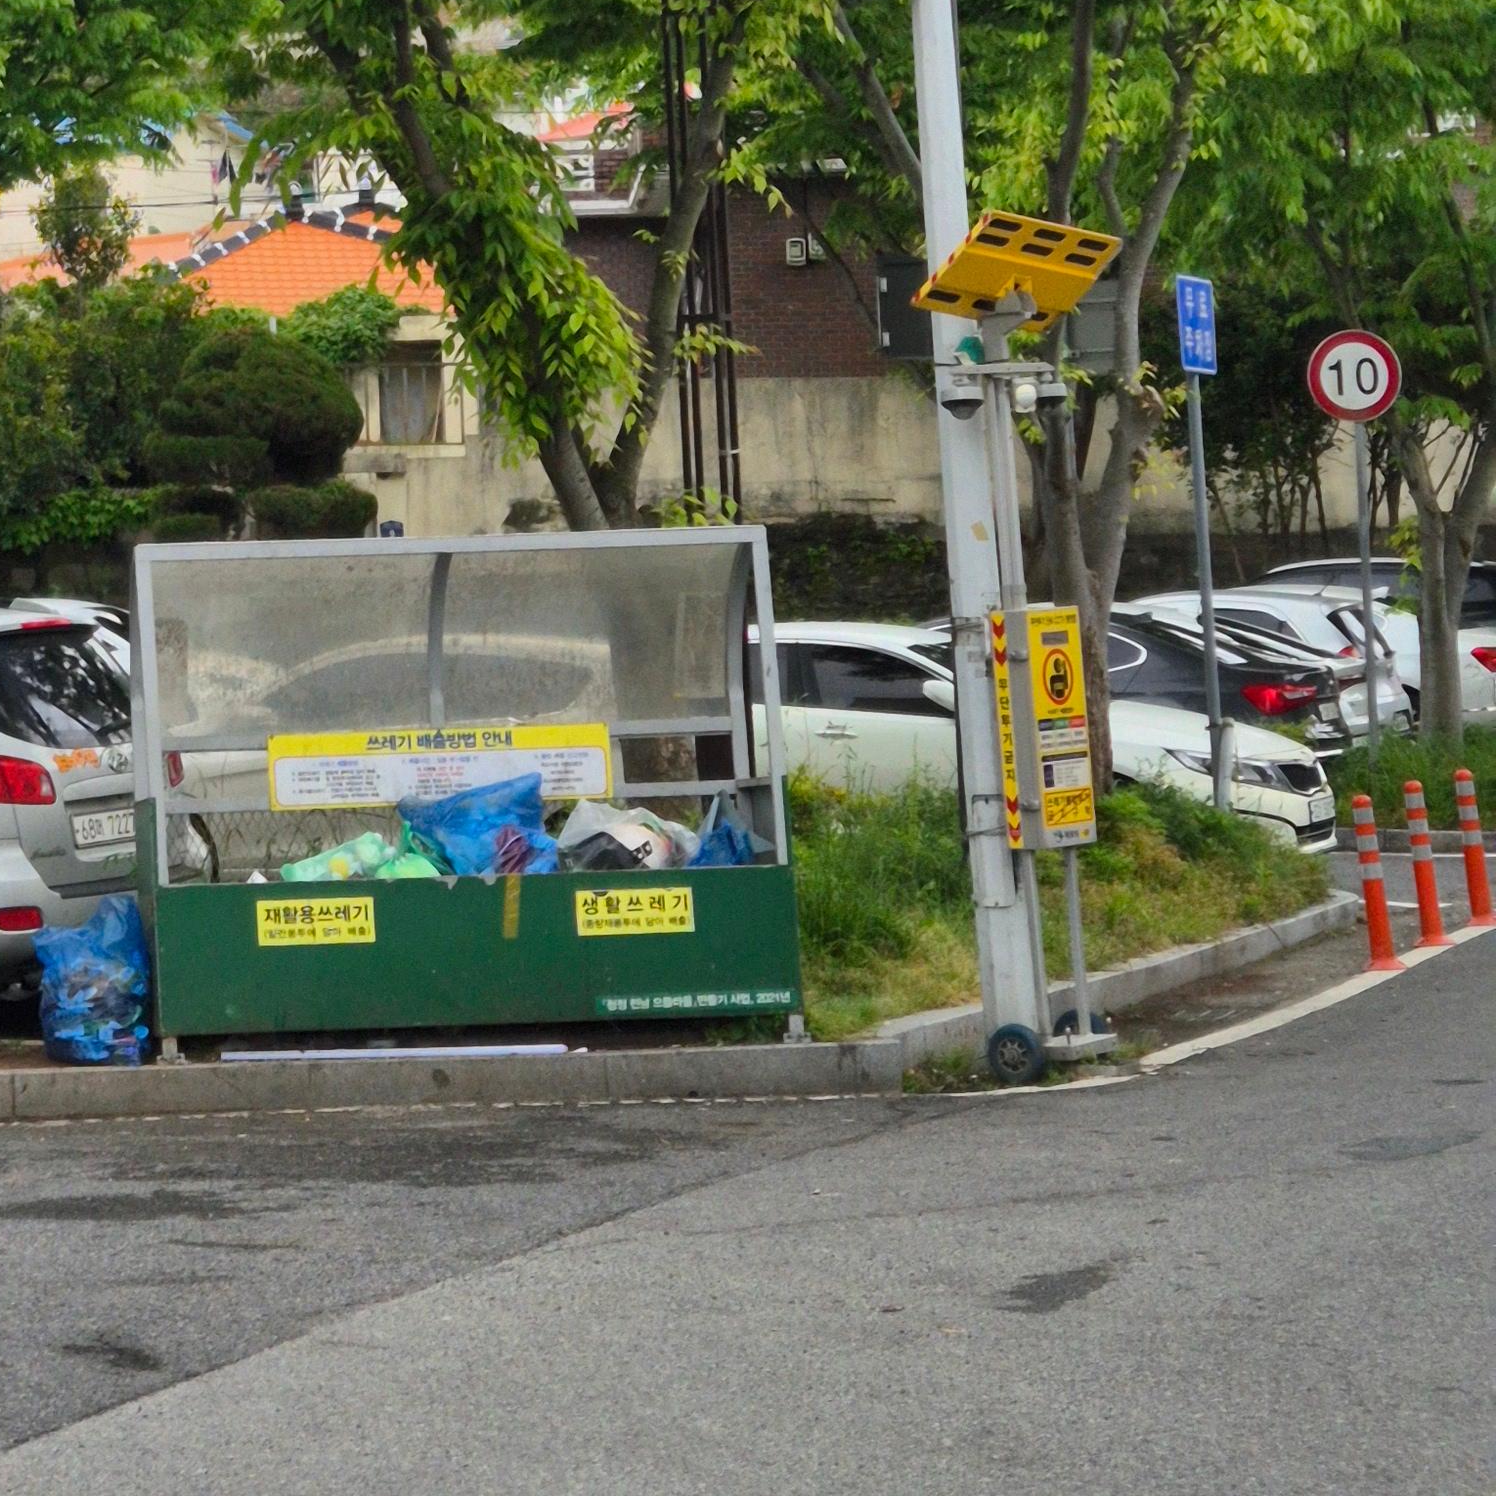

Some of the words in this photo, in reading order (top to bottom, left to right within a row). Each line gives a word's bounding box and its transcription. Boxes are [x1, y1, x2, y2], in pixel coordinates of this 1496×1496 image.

[1327, 357, 1379, 397] 10
[365, 734, 412, 751] 쓰레기
[416, 729, 477, 750] 배출방법
[481, 730, 513, 748] 안내
[263, 904, 369, 925] 재활용쓰레기
